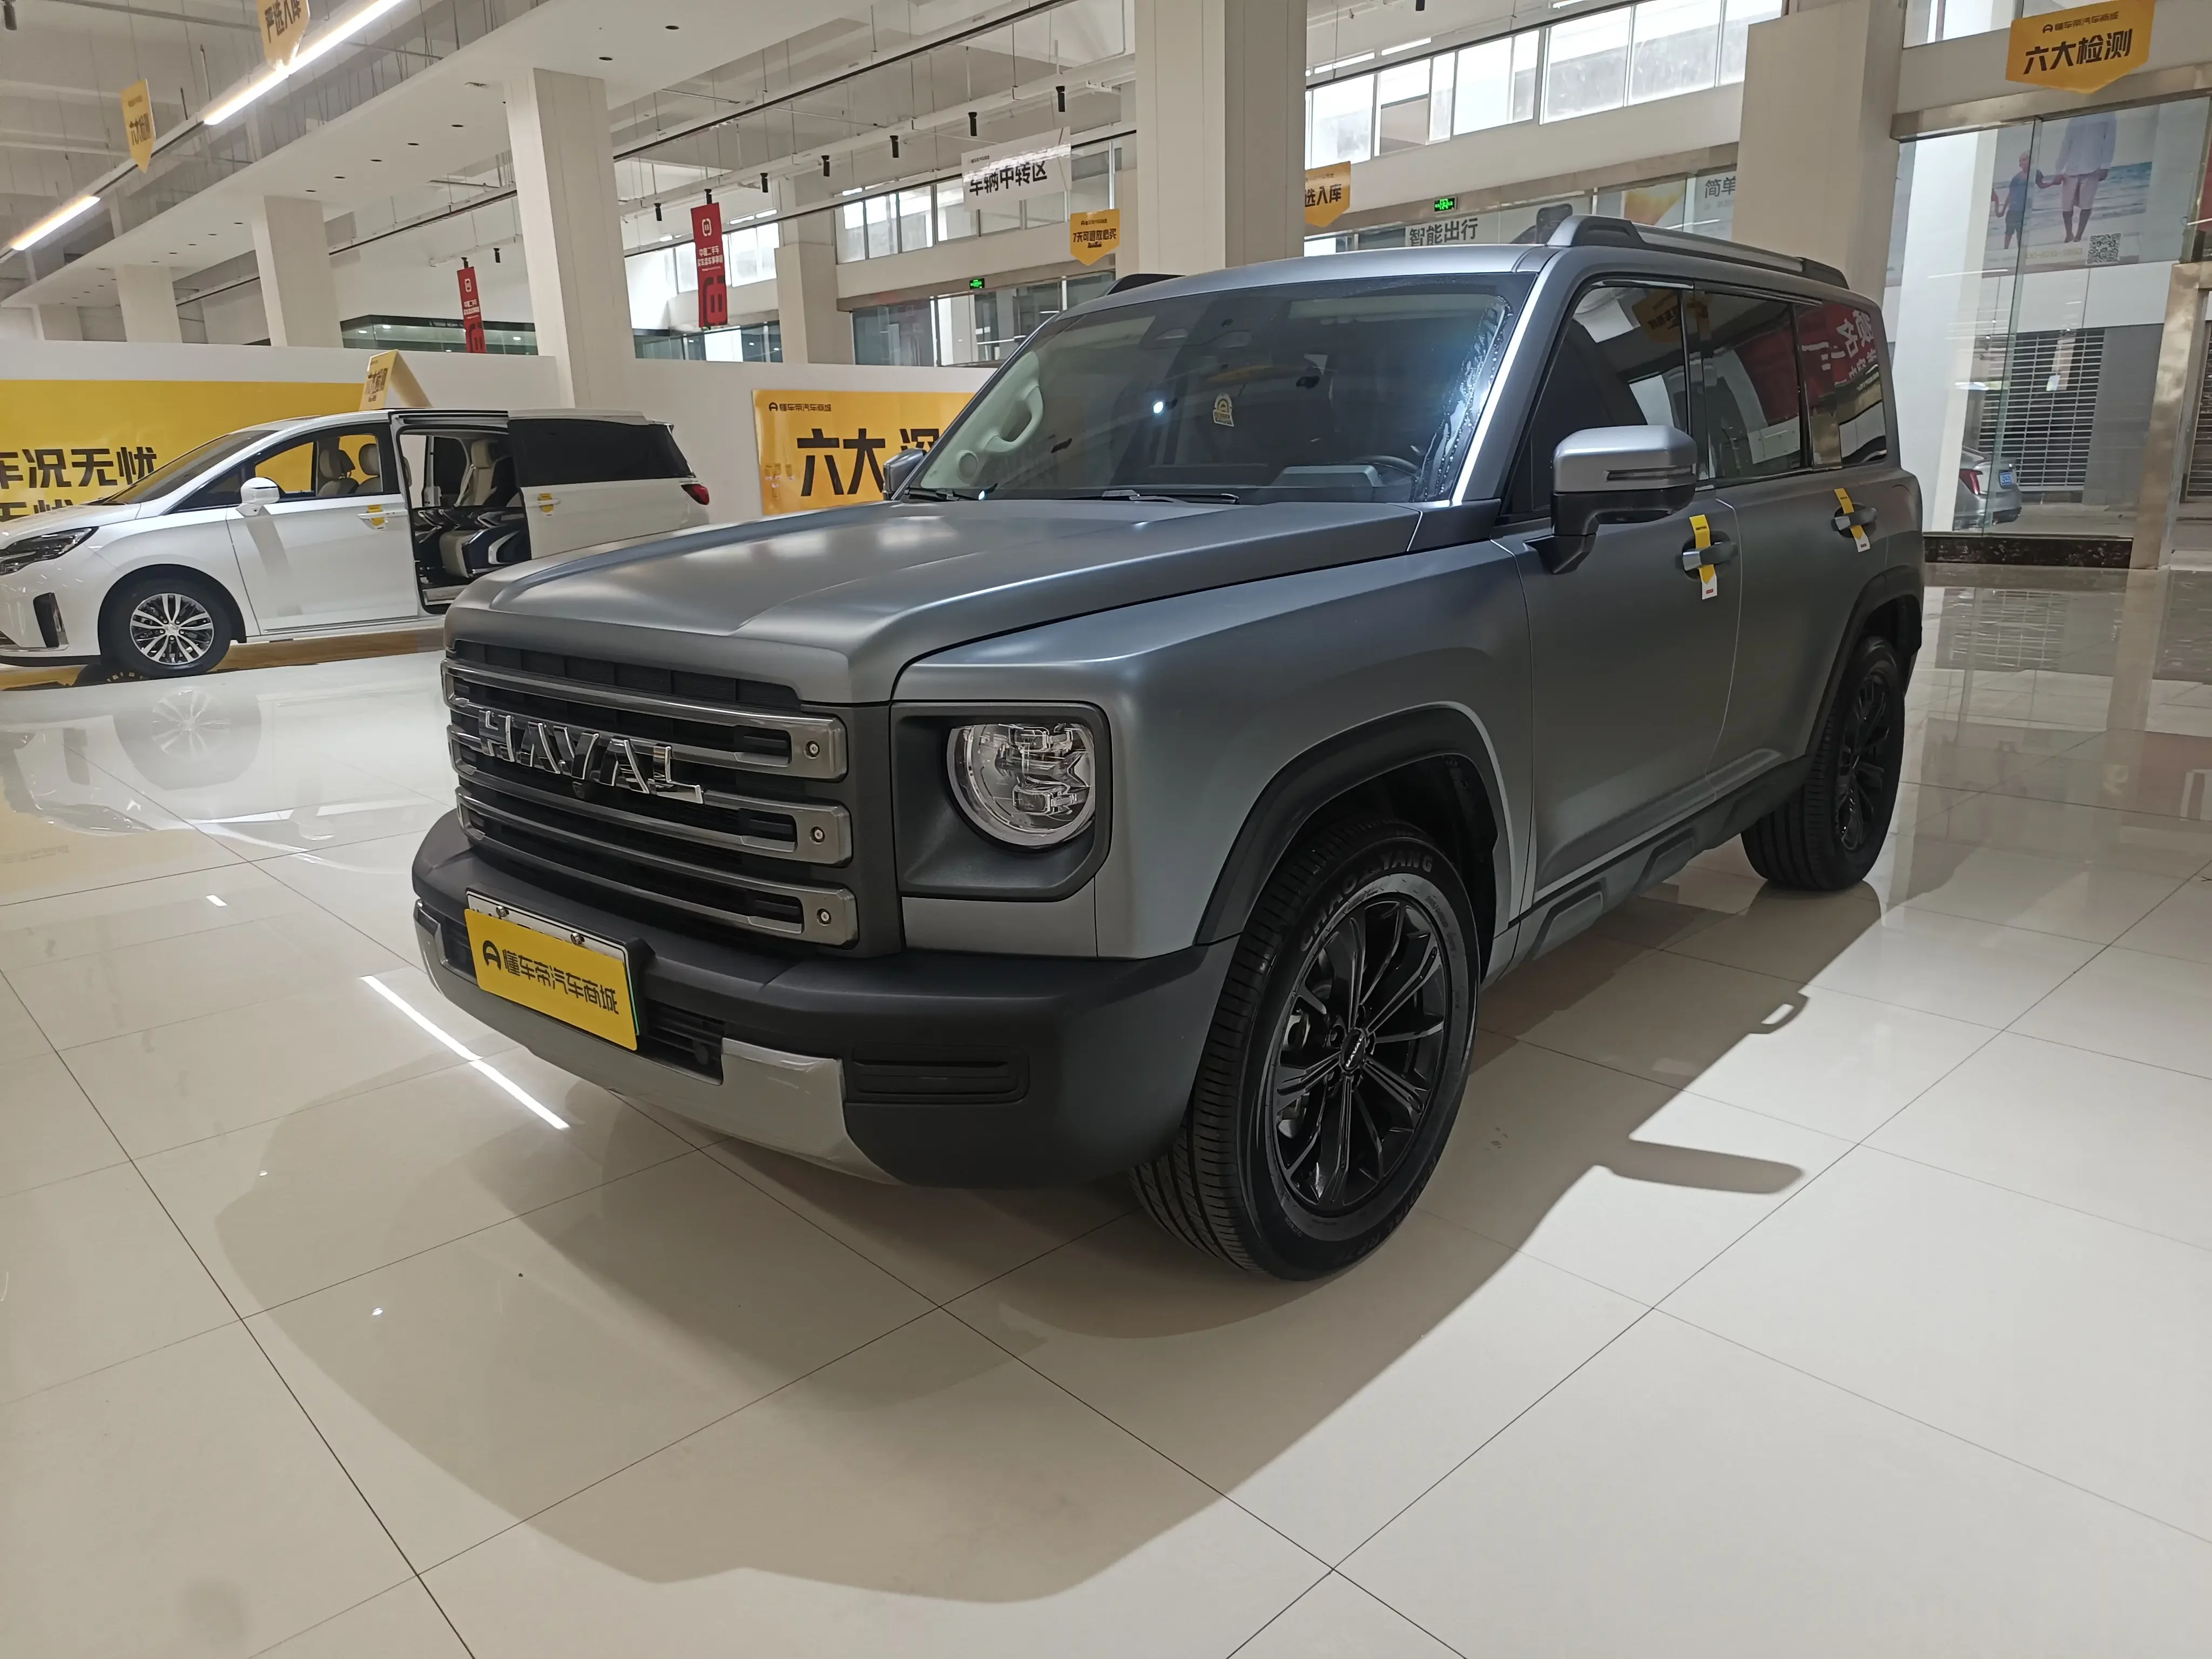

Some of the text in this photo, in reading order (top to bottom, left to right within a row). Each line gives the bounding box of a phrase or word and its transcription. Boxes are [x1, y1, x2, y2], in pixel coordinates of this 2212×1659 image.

[2022, 29, 2133, 75] 六大检测
[969, 160, 1048, 196] 车辆中转区
[1704, 176, 1736, 199] 简单
[1410, 218, 1478, 247] 智能出行
[479, 709, 704, 804] HAVAL
[502, 949, 619, 1015] 懂车帝汽车商城
